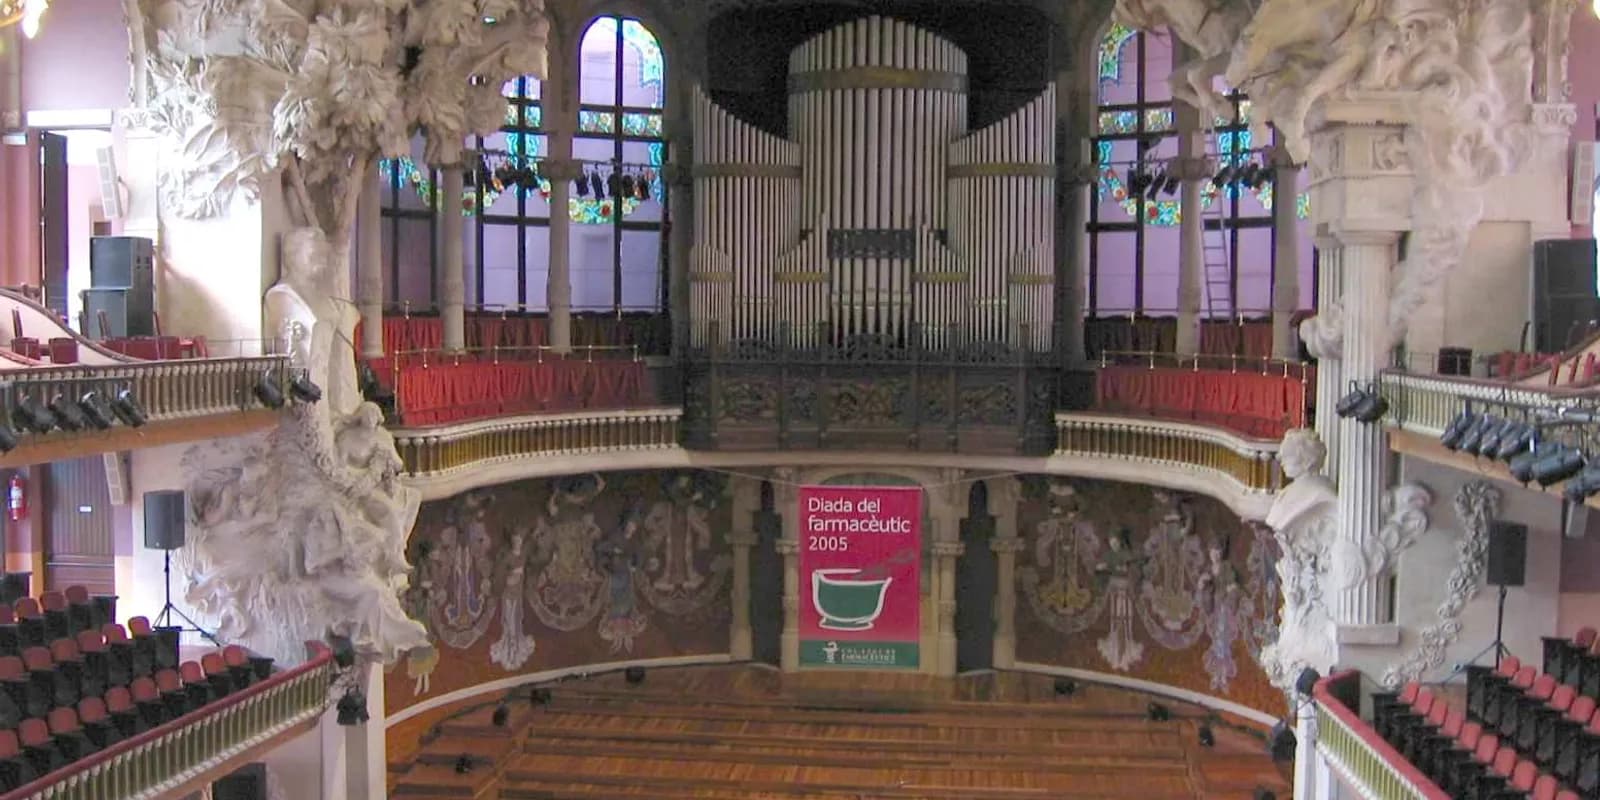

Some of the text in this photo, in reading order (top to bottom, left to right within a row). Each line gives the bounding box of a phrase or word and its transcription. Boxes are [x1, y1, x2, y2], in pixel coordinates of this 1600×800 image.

[808, 497, 881, 513] Diada del
[808, 515, 911, 533] farmacèutic
[808, 536, 848, 551] 2005
